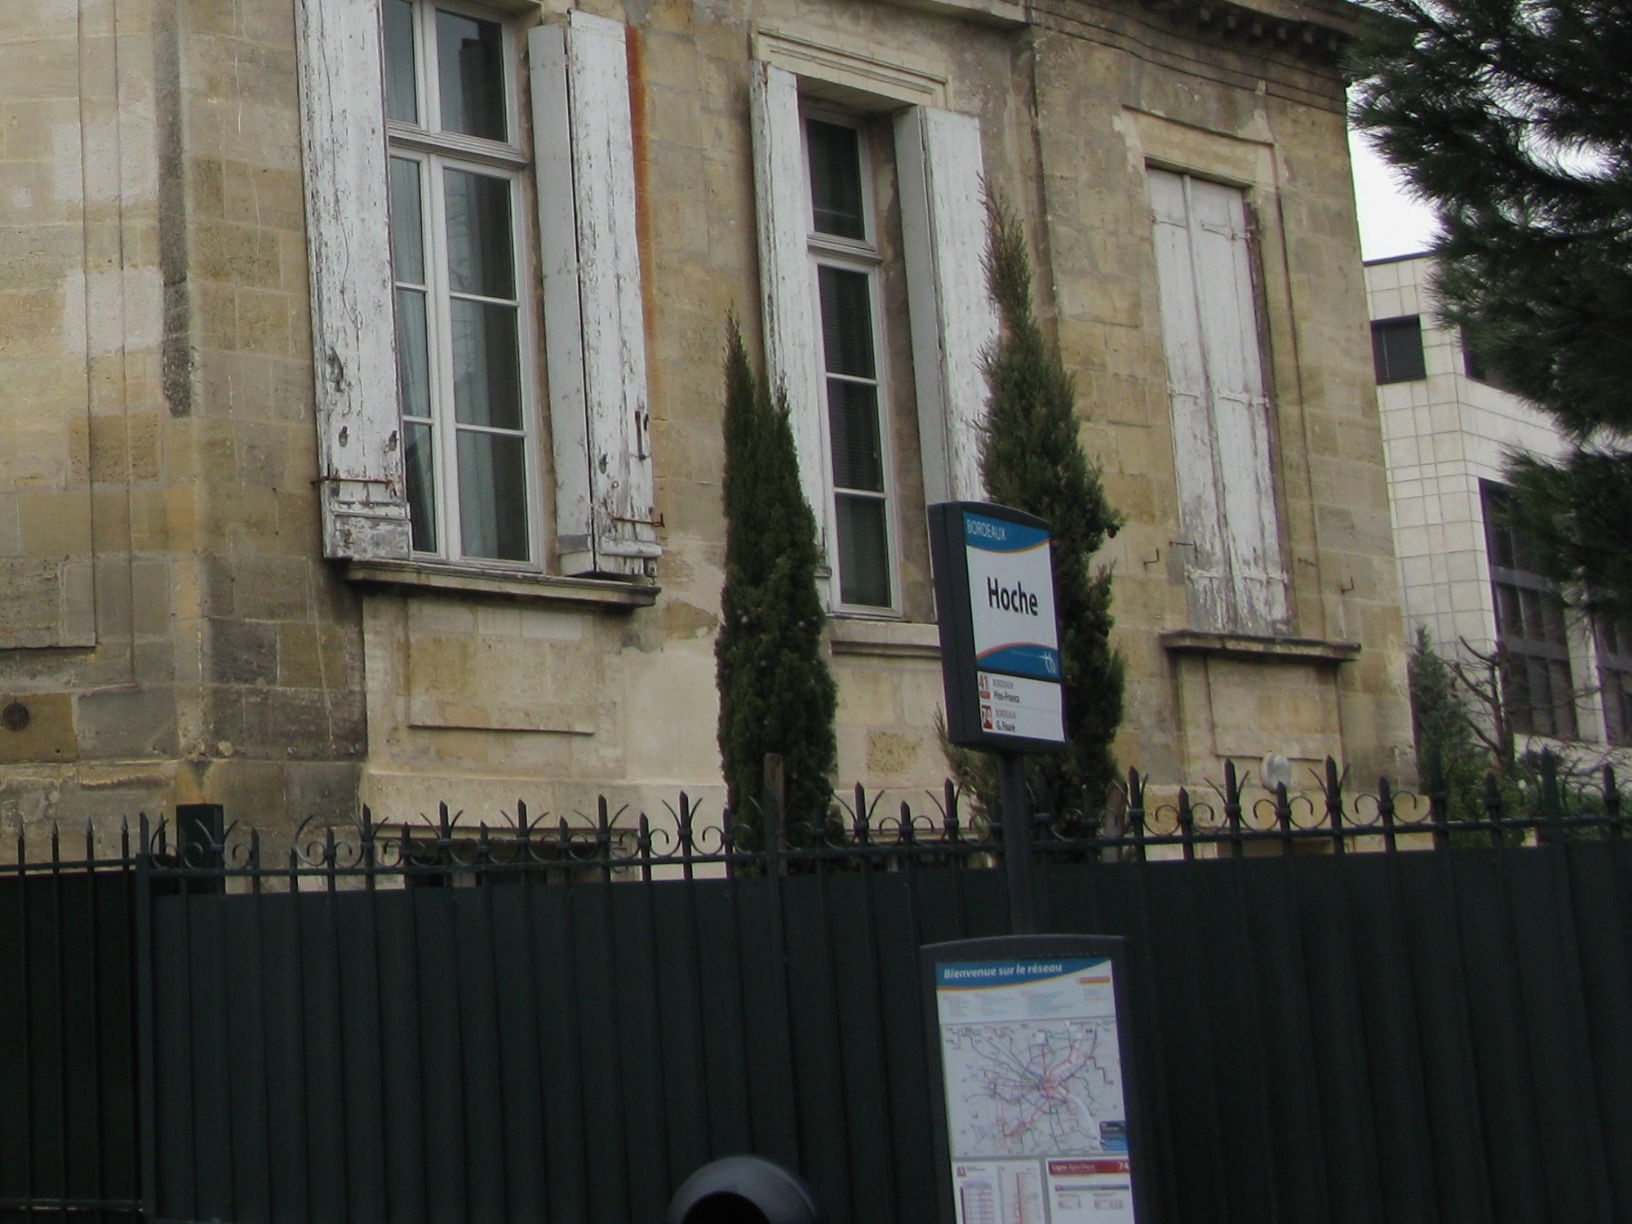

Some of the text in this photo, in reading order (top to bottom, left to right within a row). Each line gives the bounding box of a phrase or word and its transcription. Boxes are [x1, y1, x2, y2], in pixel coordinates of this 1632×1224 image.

[966, 519, 1007, 541] BORDEAUX
[986, 576, 1039, 616] Hoche
[979, 674, 989, 690] 41
[943, 963, 1063, 980] Bienvenue sur le réseau
